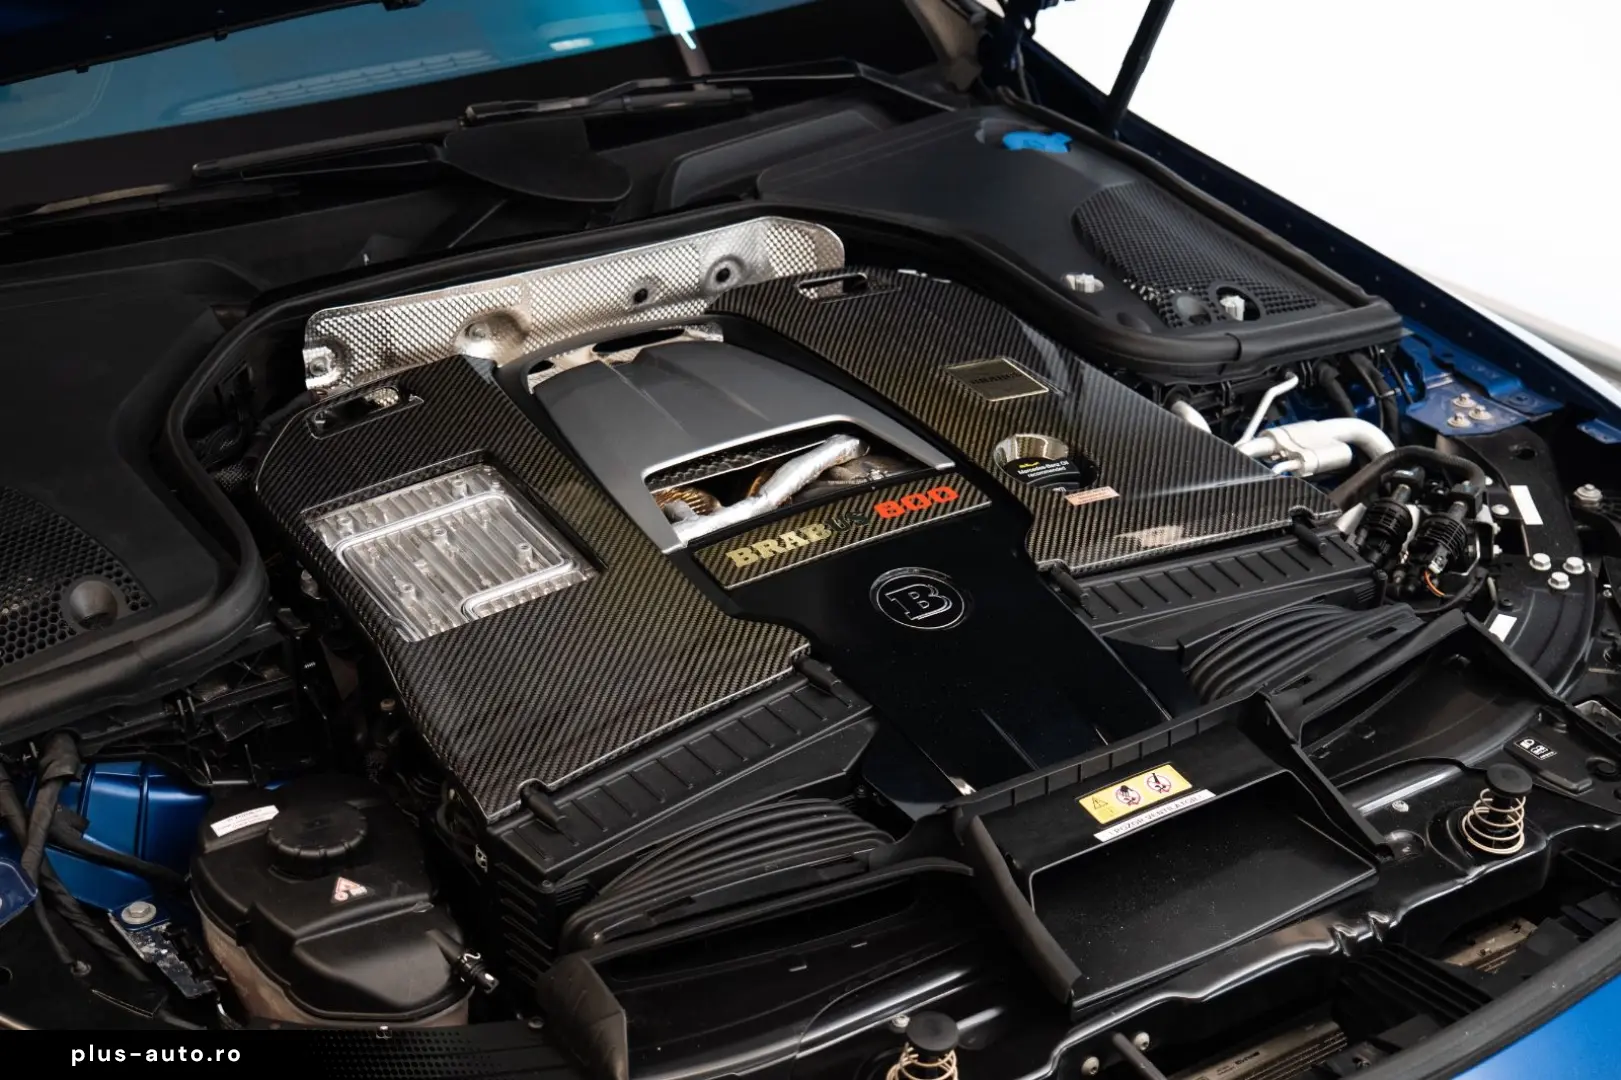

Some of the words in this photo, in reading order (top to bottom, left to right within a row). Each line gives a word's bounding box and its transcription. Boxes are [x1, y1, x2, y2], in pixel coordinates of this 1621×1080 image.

[1027, 466, 1066, 477] recommended
[725, 511, 870, 568] BRABUS
[873, 485, 960, 519] 800
[884, 583, 953, 621] B
